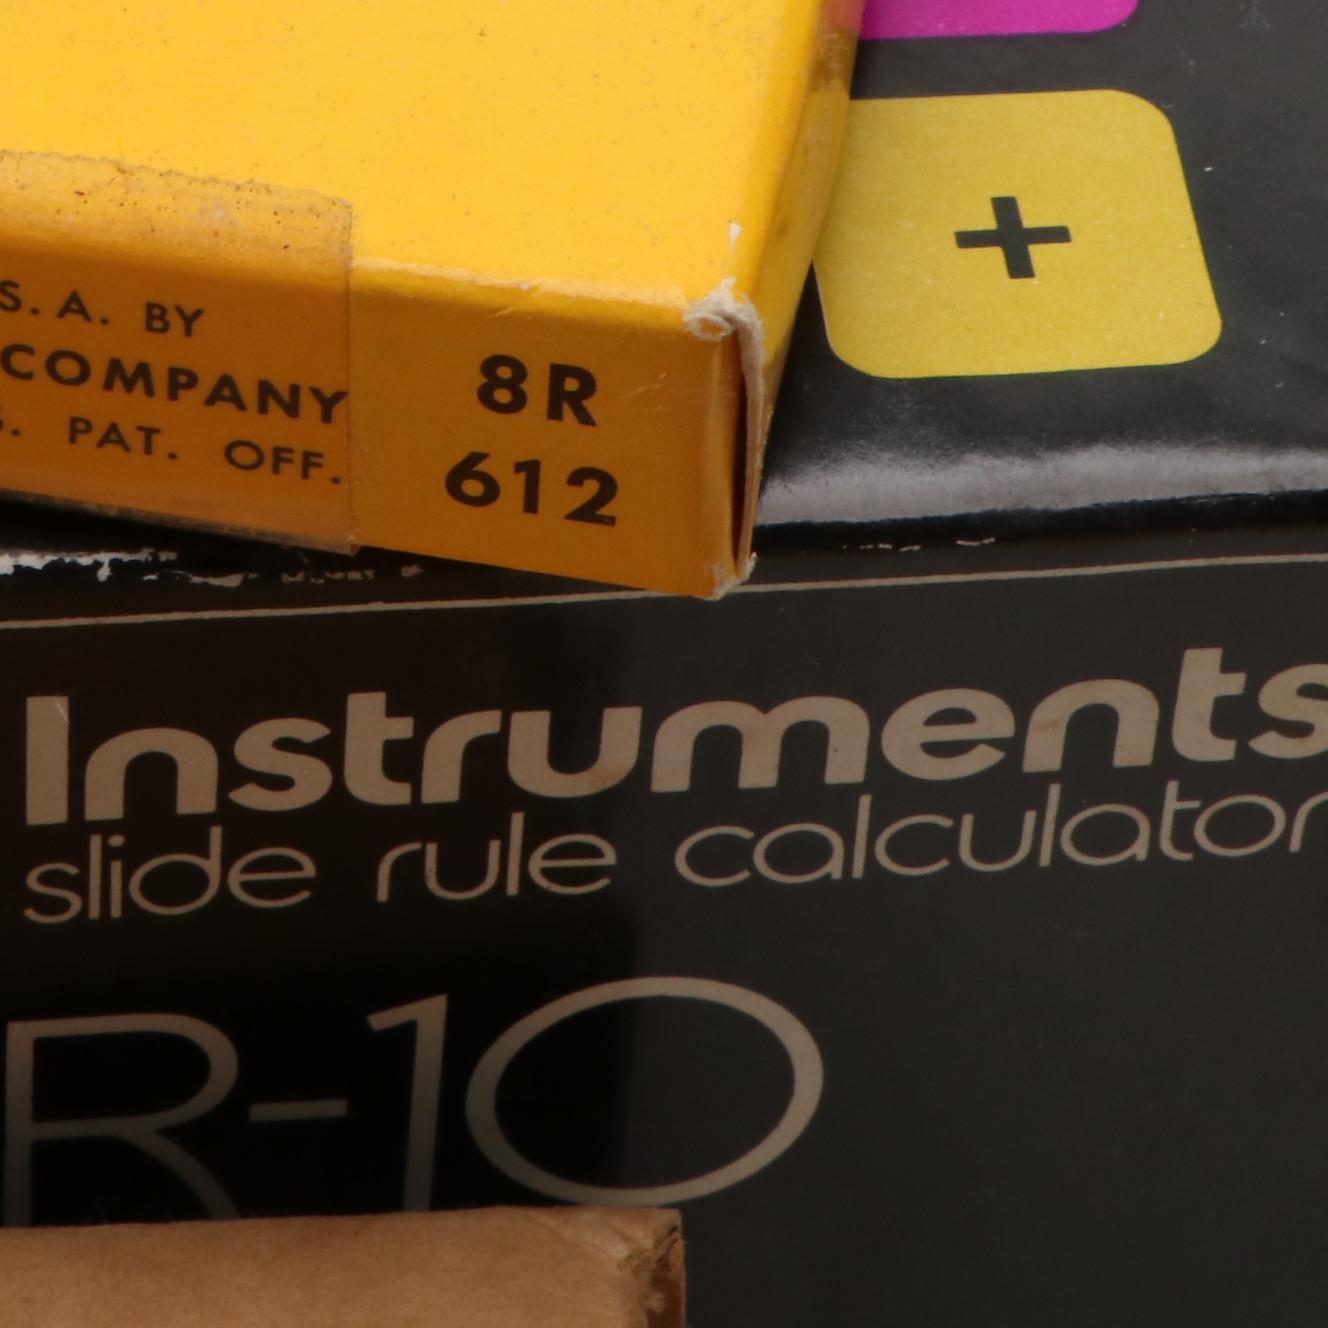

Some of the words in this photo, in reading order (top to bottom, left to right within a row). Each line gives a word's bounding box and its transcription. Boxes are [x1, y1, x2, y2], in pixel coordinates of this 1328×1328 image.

[144, 301, 204, 337] BY
[0, 343, 349, 424] COMPANY
[476, 354, 598, 427] 8R
[68, 416, 177, 460] PAT.
[223, 440, 341, 484] OFF.
[445, 452, 619, 528] 612
[25, 647, 1328, 827] Instruments
[24, 824, 317, 924] slide
[376, 812, 617, 903] rule
[674, 779, 1328, 889] calculator
